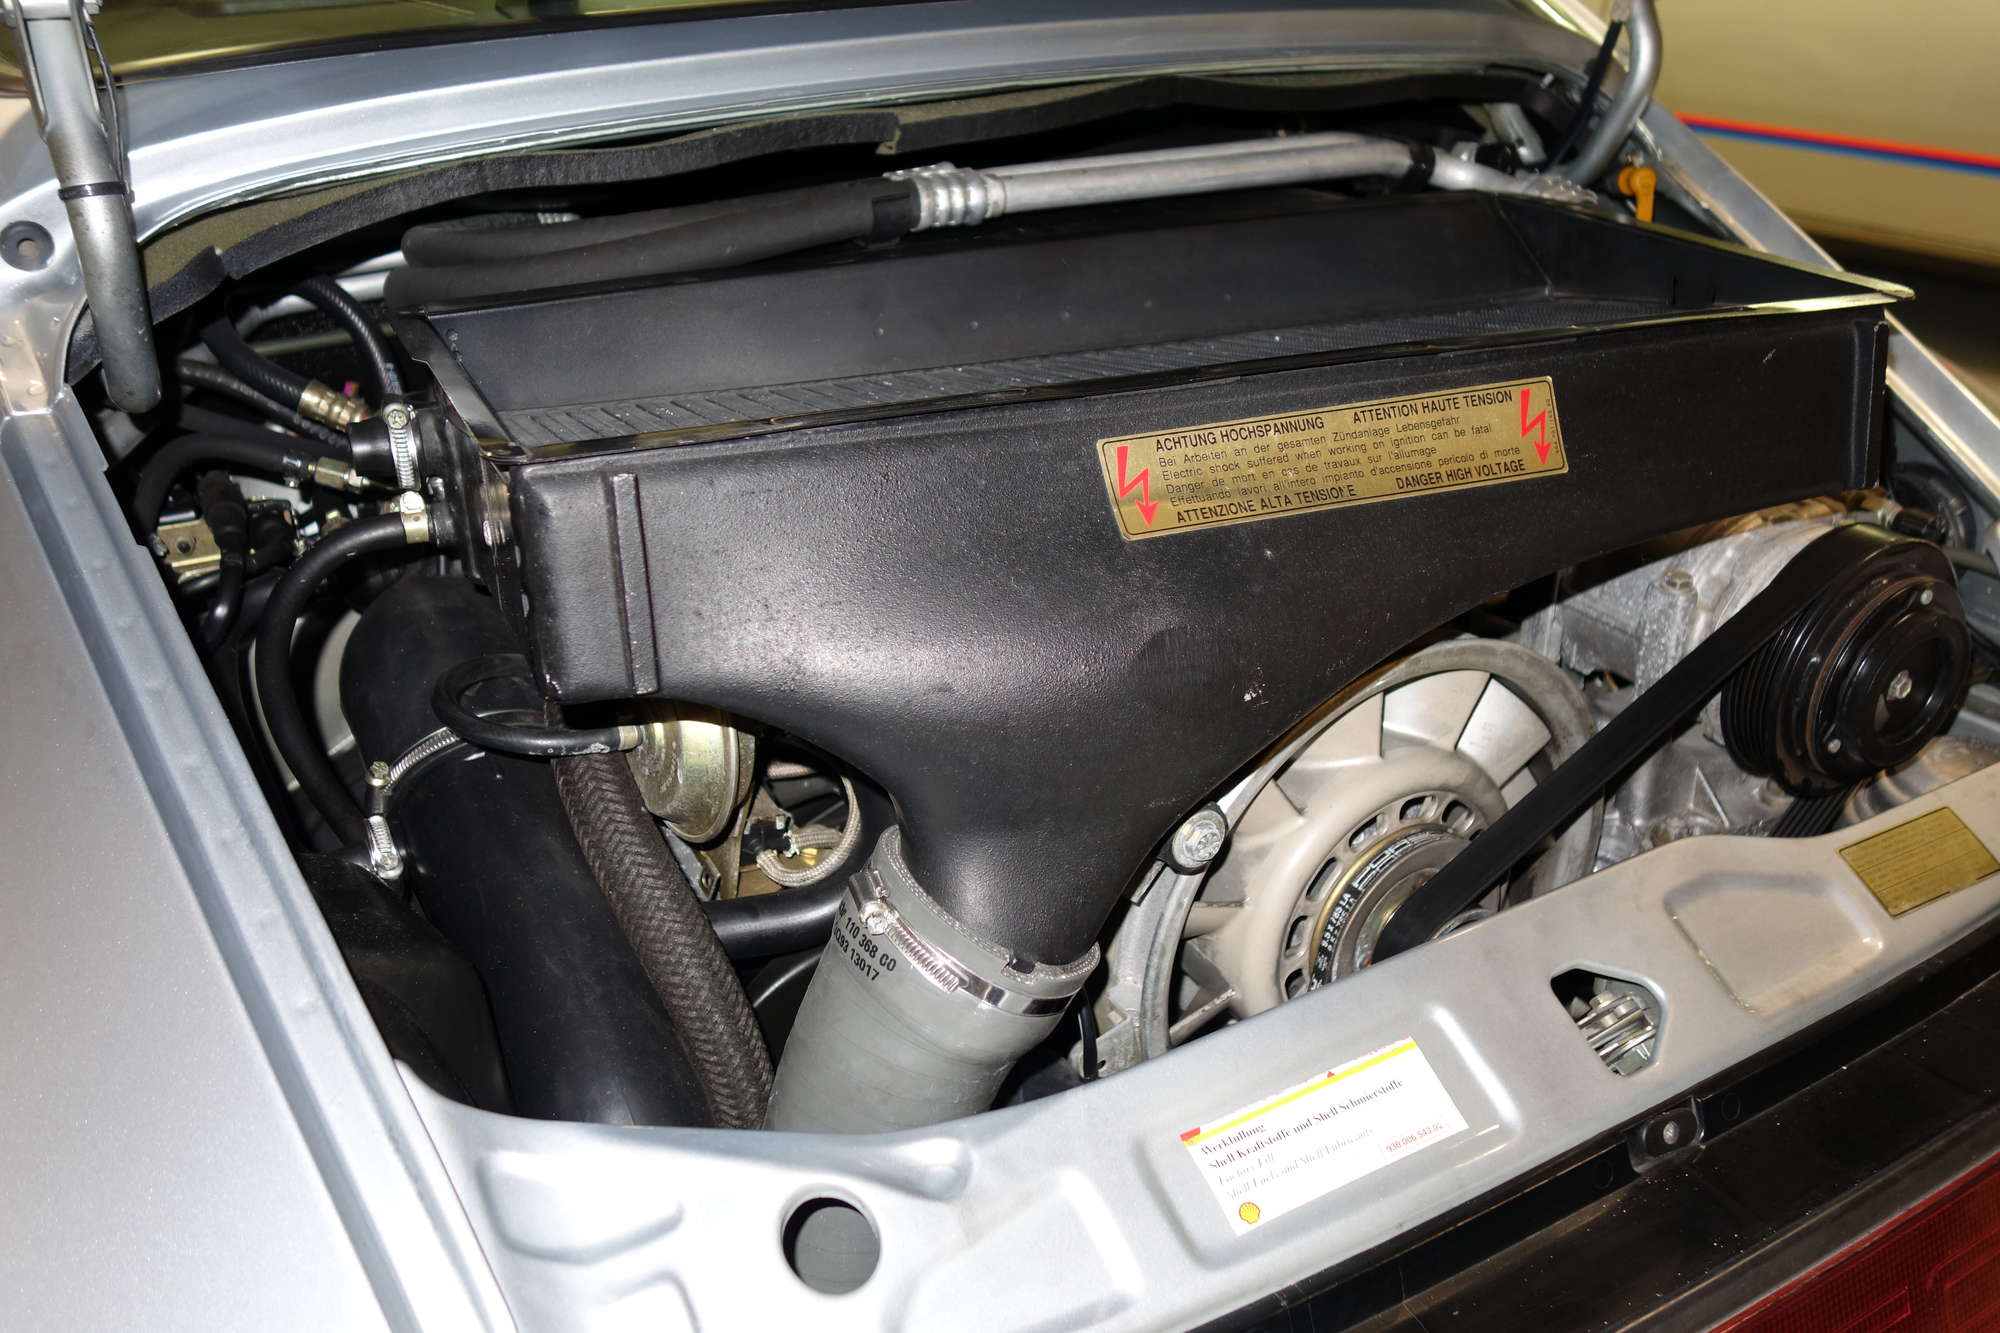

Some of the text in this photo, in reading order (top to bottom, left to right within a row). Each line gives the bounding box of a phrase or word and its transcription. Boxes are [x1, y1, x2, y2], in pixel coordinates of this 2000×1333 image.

[1353, 390, 1513, 424] ATTENTION HAUTE TENSION
[1156, 417, 1324, 452] ACHTUNG HOCHSPANNUNG
[1160, 416, 1460, 467] Bei Arbeiten an der gesamten Zündanlage Lebensgefahr
[1163, 423, 1492, 481] Electric shock suffered when working on ignition can be fatal
[1166, 446, 1437, 495] Danger de mort en cas de travaux sur l'allumage
[1170, 446, 1520, 507] Effettuando lavori all'intero impianto d'accensione pericolo di morte
[1396, 459, 1525, 489] DANGER HIGH VOLTAGE
[1177, 485, 1356, 523] ATTENZIONE ALTA TENSIONE
[845, 917, 859, 938] 110
[859, 934, 878, 958] 368
[850, 949, 880, 980] 13017
[1313, 1103, 1339, 1126] Shell
